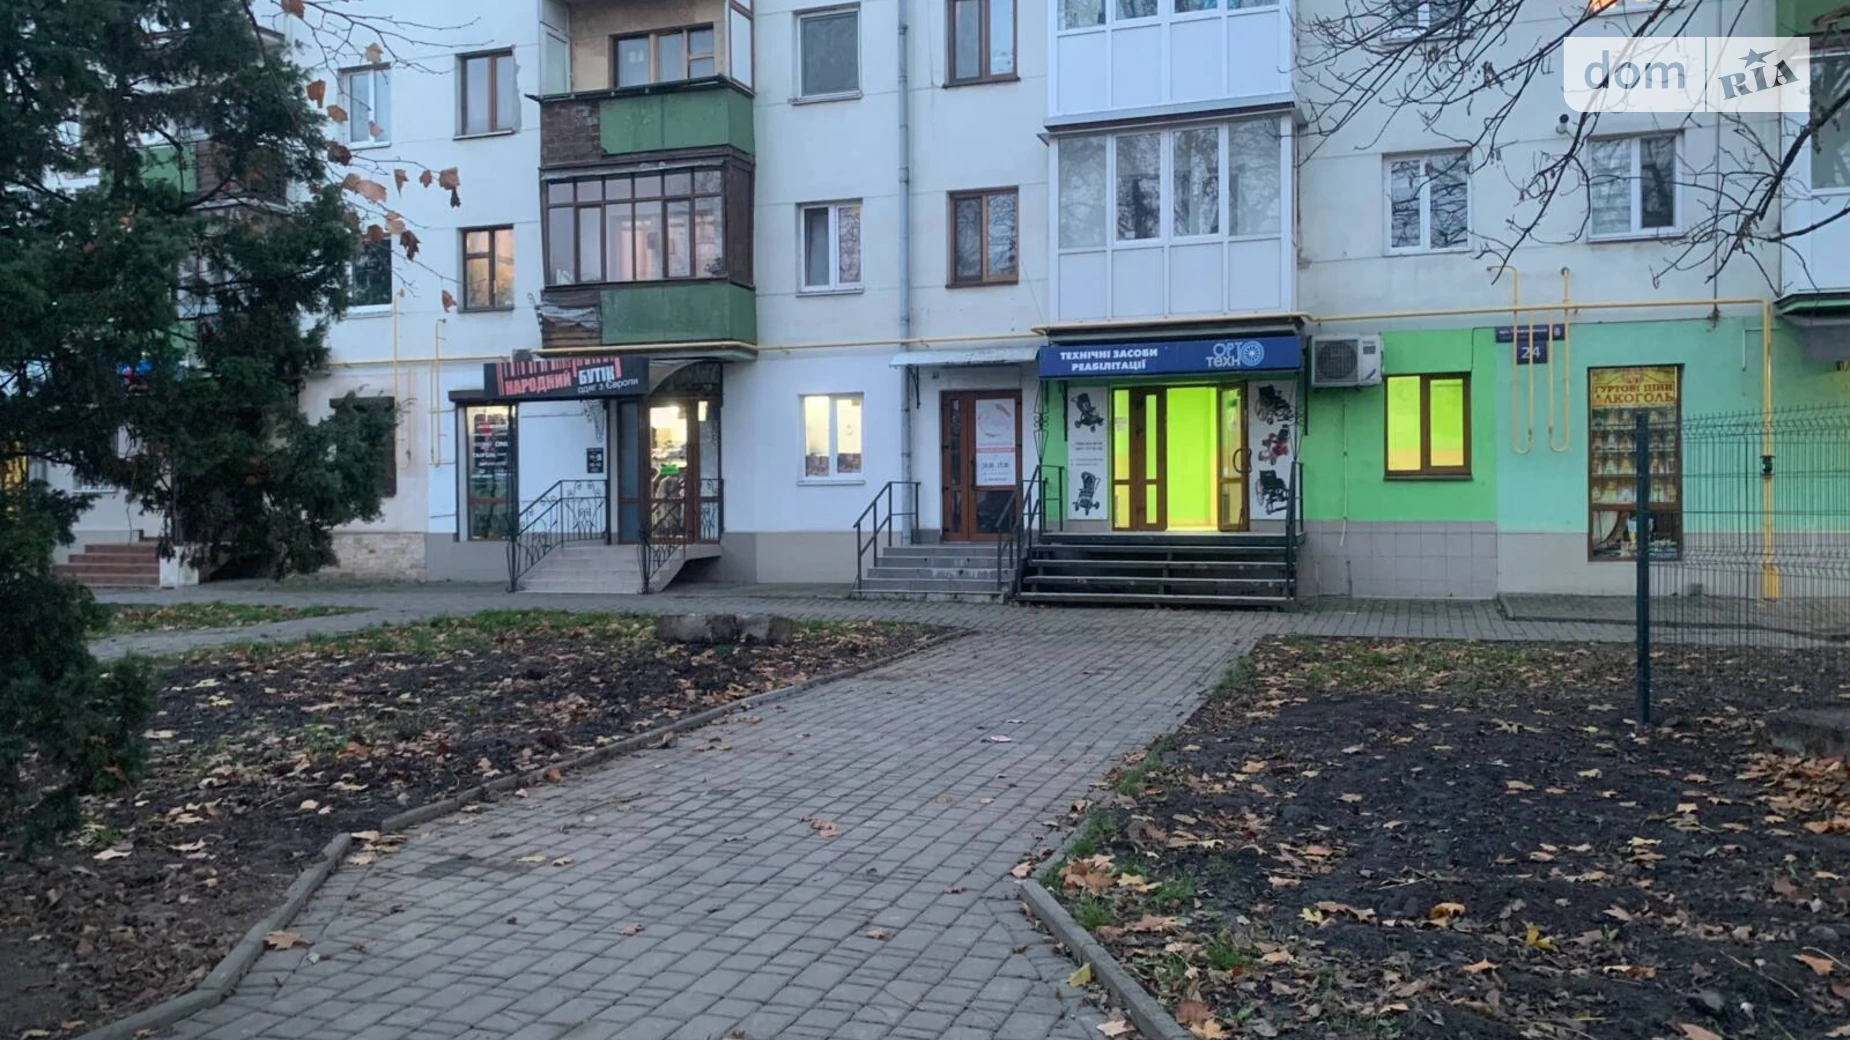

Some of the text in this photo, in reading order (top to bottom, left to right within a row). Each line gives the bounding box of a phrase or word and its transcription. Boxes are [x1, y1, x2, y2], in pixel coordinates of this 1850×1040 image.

[1060, 348, 1158, 361] ТЕХНІЧНІ ЗАСОБИ
[1520, 346, 1541, 359] 24
[1071, 359, 1147, 371] РЕАБІЛІТАЦІЇ
[504, 365, 615, 396] НАРОДНИЙ БУТІК
[605, 378, 639, 390] Європи
[1594, 383, 1639, 393] ГУРТОВІ
